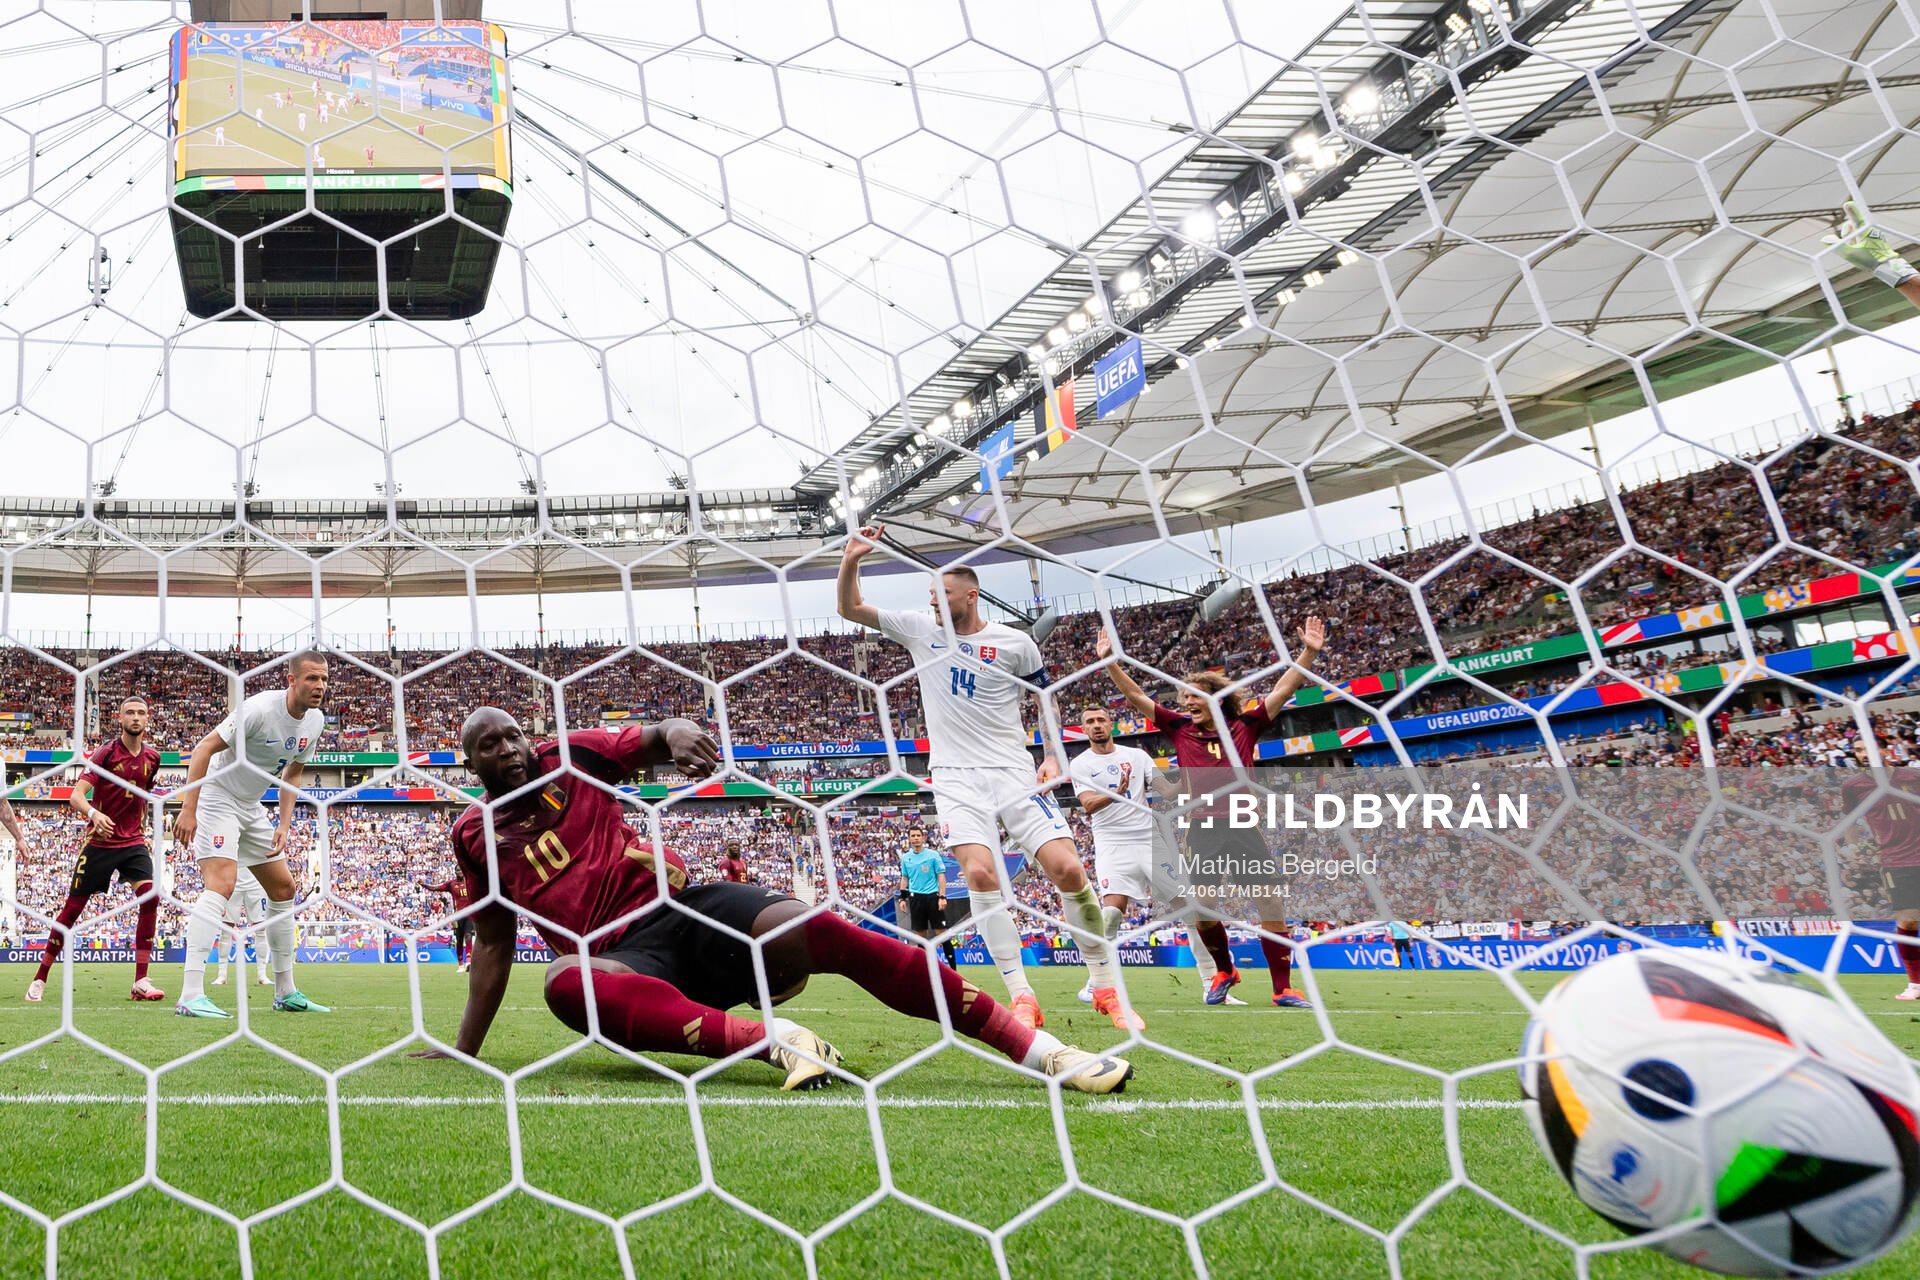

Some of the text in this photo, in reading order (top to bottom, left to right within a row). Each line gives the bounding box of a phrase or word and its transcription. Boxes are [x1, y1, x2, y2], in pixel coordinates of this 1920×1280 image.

[286, 176, 399, 187] FRANKFURT
[1098, 357, 1138, 397] UEFA
[950, 667, 976, 698] 14
[1207, 741, 1221, 760] 4
[1887, 803, 1906, 821] 11
[77, 855, 88, 874] 2
[524, 830, 570, 883] 10
[73, 950, 164, 962] SMARTPHNE
[963, 949, 984, 963] vivo
[1054, 950, 1087, 963] OFFICIA
[1344, 945, 1397, 966] vivo
